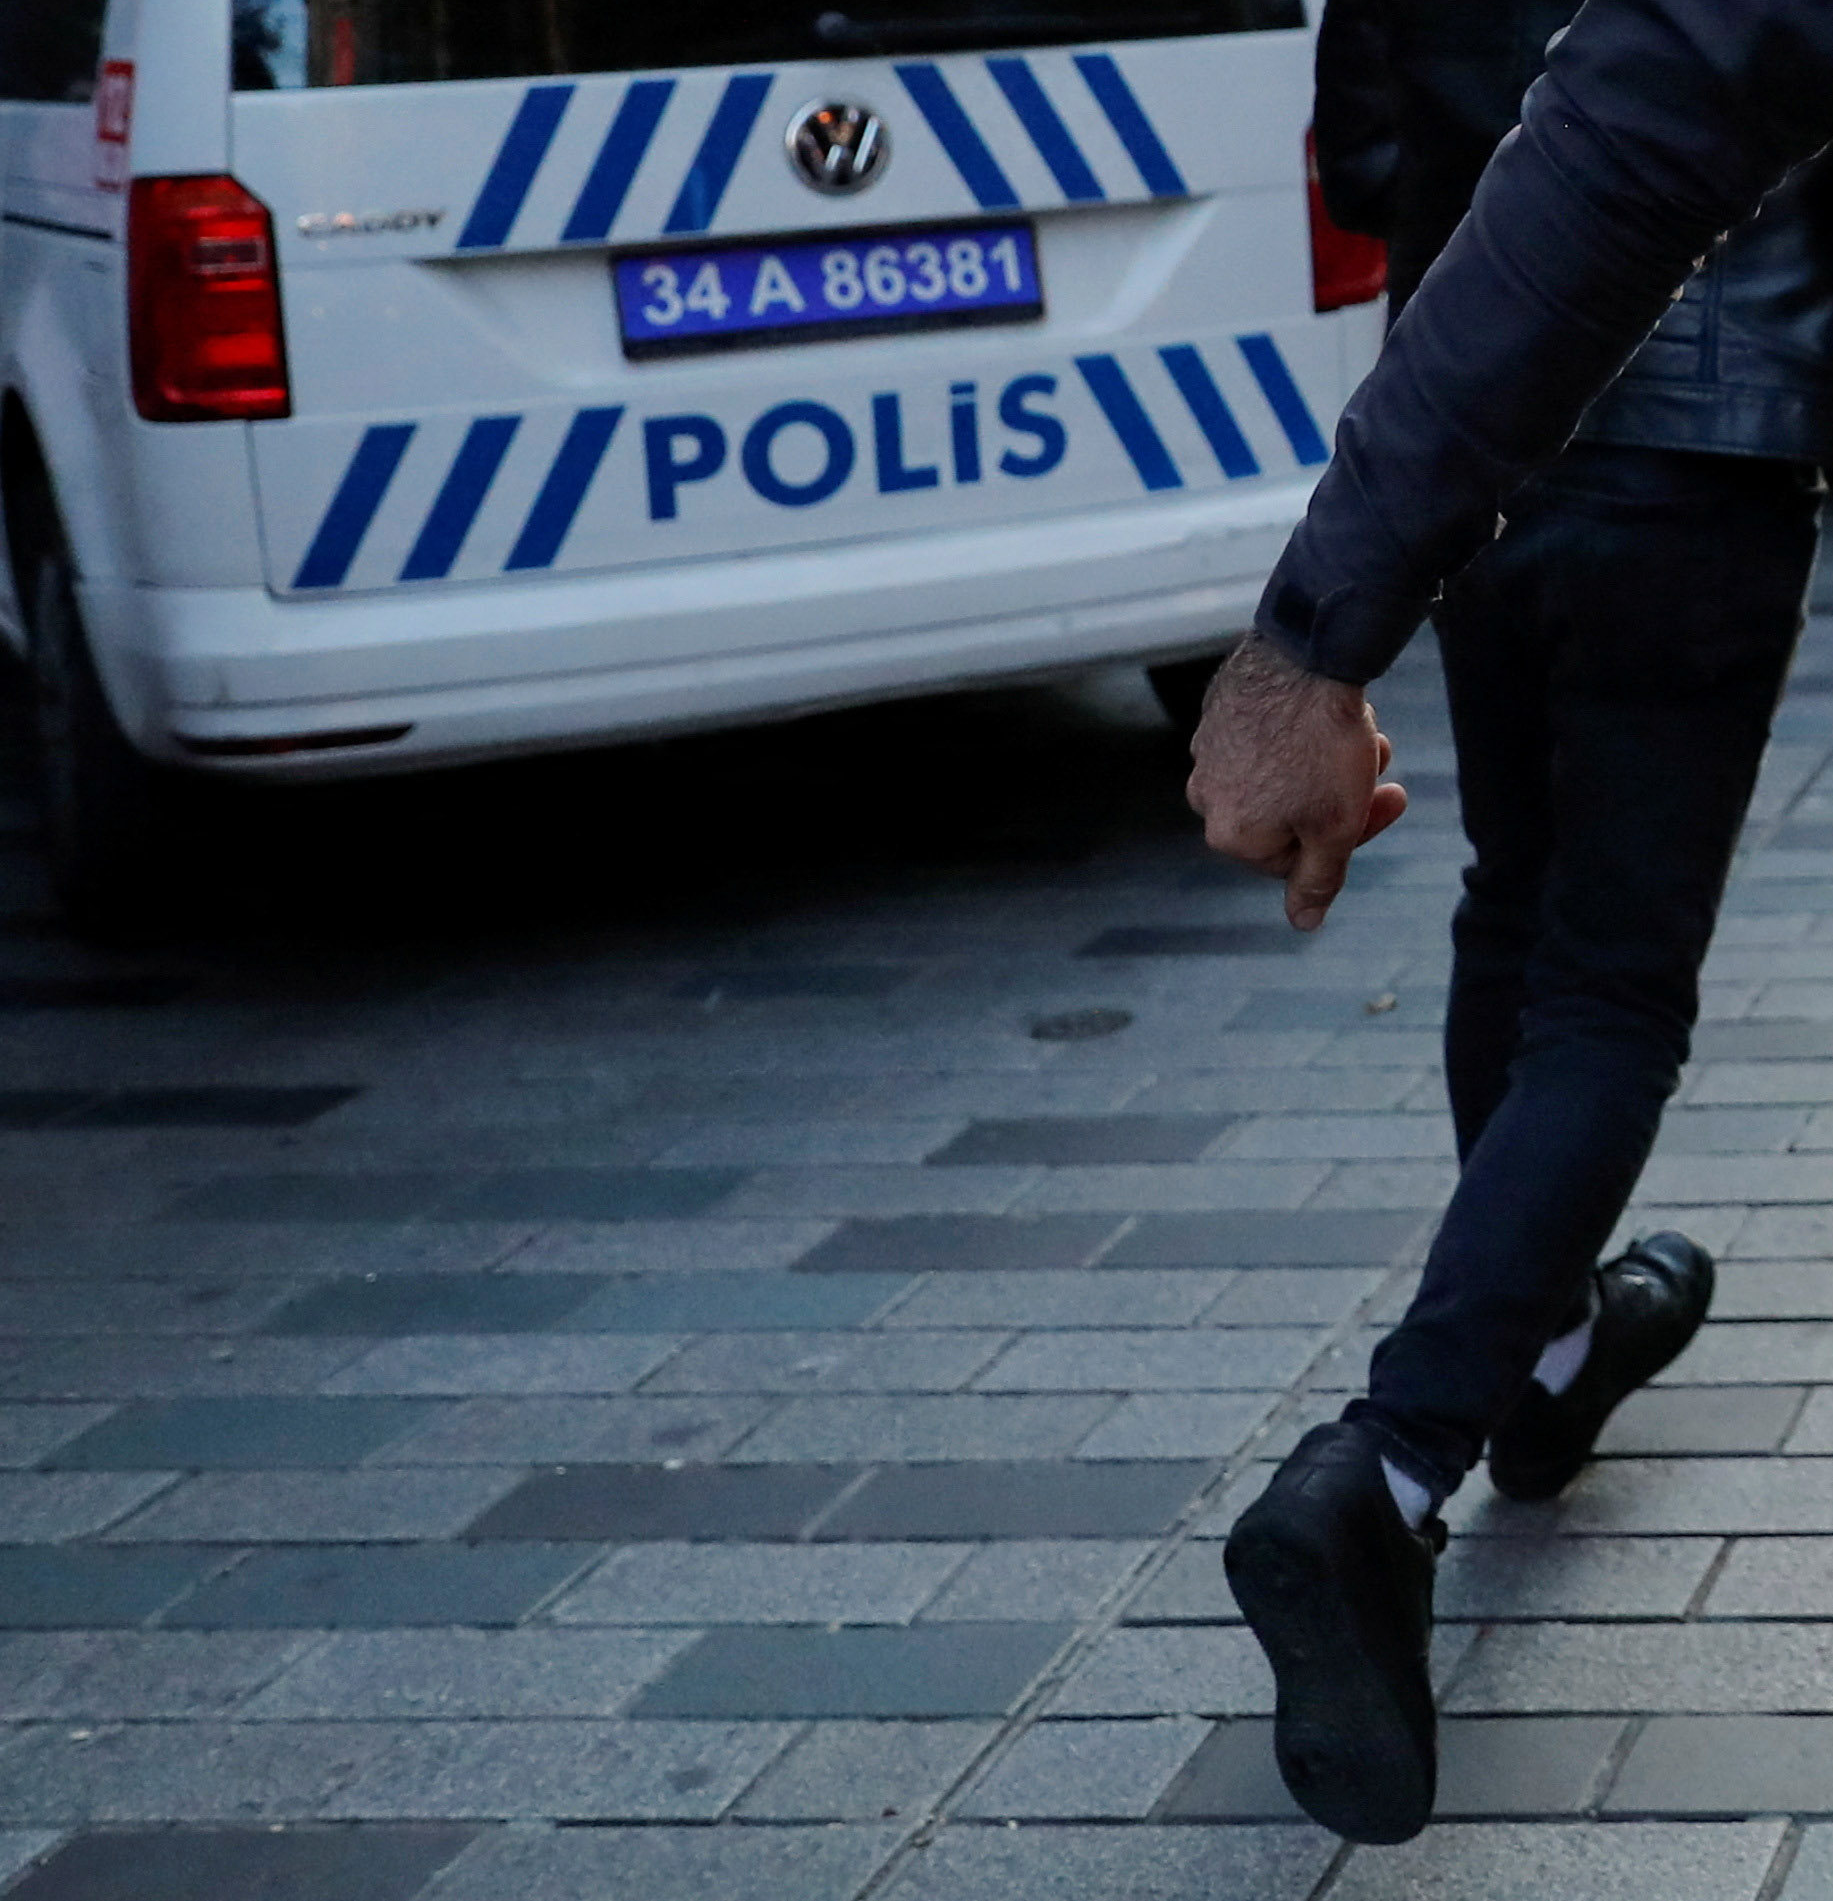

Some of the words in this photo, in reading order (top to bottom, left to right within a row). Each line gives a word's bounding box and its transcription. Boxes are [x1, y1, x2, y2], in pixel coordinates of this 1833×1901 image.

[640, 260, 732, 327] 34
[749, 254, 806, 317] A
[821, 236, 1023, 310] 86381
